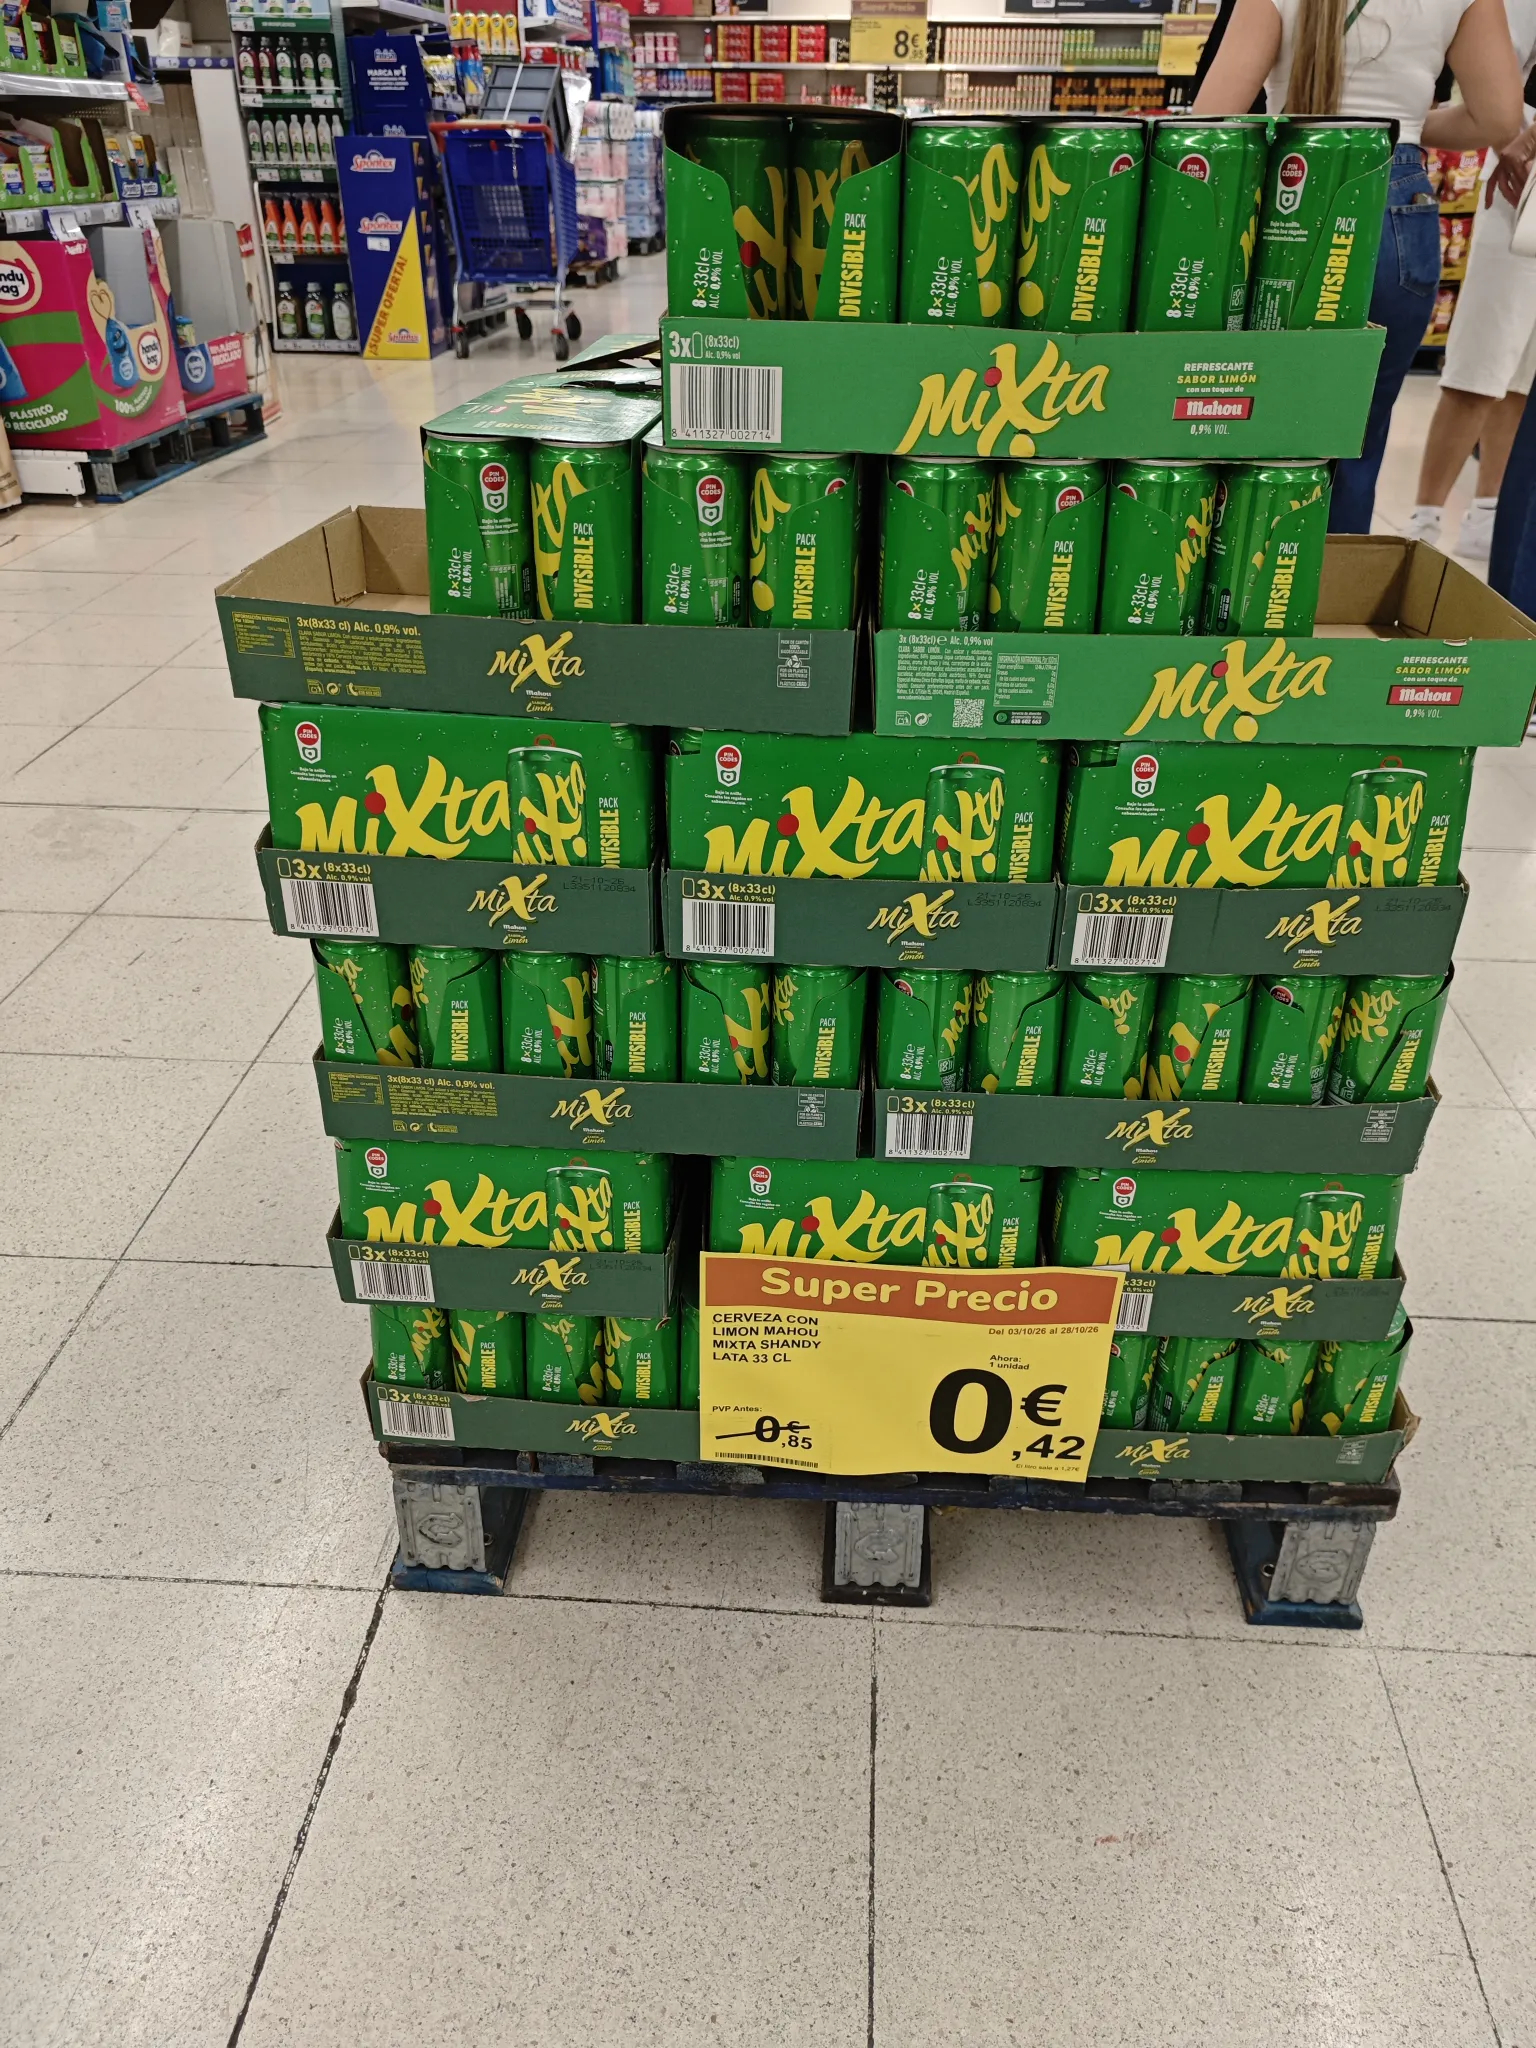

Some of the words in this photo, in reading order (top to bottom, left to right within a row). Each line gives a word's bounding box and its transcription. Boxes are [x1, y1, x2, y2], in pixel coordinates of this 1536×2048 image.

[844, 213, 866, 228] PACK
[1084, 217, 1107, 233] PACK
[1335, 216, 1357, 233] PACK
[1184, 362, 1254, 371] REFRESCANTE
[1177, 374, 1215, 385] SABOR
[1219, 372, 1257, 384] LIMÓN
[1186, 400, 1242, 416] Mahou
[1190, 424, 1212, 436] 0,9%
[573, 523, 593, 535] PACK
[796, 533, 816, 545] PACK
[1053, 541, 1074, 553] PACK
[1279, 542, 1299, 554] PACK
[354, 622, 372, 632] Alc.
[1403, 656, 1468, 664] REFRESCANTE
[1435, 665, 1470, 674] LIMÓN
[1399, 688, 1452, 702] Mahou
[1405, 708, 1424, 718] 0,9%
[599, 797, 619, 809] PACK
[1014, 811, 1034, 824] PACK
[1430, 815, 1451, 826] PACK
[293, 858, 321, 880] 3x
[323, 862, 371, 875] (8x33cl)
[696, 879, 726, 899] 3x
[728, 882, 776, 895] (8x33cl)
[1094, 893, 1123, 913] 3x
[1127, 895, 1177, 908] (8x33cl)
[451, 1000, 468, 1009] PACK
[629, 1012, 646, 1021] PACK
[819, 1017, 836, 1027] PACK
[1025, 1026, 1042, 1035] PACK
[1214, 1028, 1231, 1038] PACK
[437, 1078, 453, 1087] Alc.
[901, 1096, 928, 1114] 3x
[931, 1099, 975, 1110] (8x33cl)
[623, 1201, 640, 1210] PACK
[1003, 1217, 1020, 1226] PACK
[1368, 1224, 1385, 1233] PACK
[362, 1246, 386, 1260] 3x
[388, 1248, 430, 1259] (8x33cl)
[761, 1267, 901, 1306] Super
[914, 1279, 1058, 1312] Precio
[712, 1313, 783, 1324] CERVEZA
[786, 1315, 819, 1326] CON
[713, 1326, 759, 1337] LIMON
[764, 1326, 819, 1338] MAHOU
[988, 1327, 1004, 1335] Del
[1008, 1327, 1046, 1335] 03/10/26
[1049, 1327, 1058, 1335] al
[1061, 1326, 1099, 1334] 28/10/26
[713, 1339, 757, 1350] MIXTA
[760, 1339, 821, 1350] SHANDY
[713, 1351, 749, 1363] LATA
[752, 1353, 768, 1363] 33
[772, 1353, 791, 1362] CL
[989, 1355, 1022, 1363] Ahora:
[997, 1362, 1030, 1370] unidad
[929, 1368, 1013, 1454] 0
[1020, 1384, 1068, 1427] €
